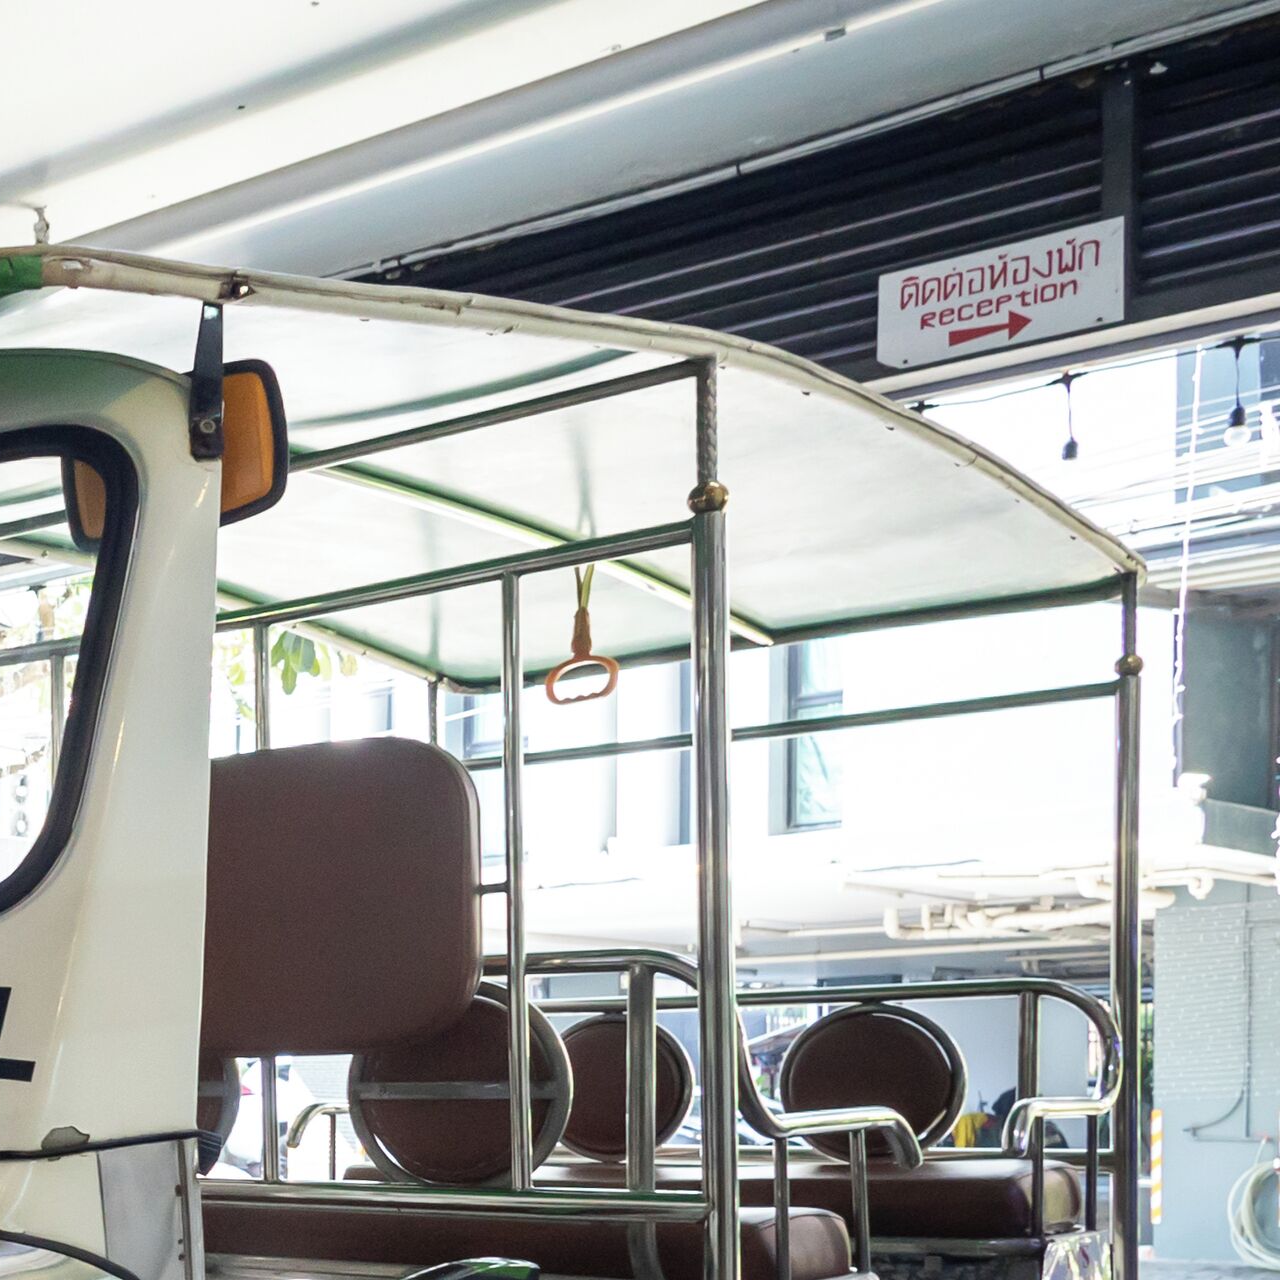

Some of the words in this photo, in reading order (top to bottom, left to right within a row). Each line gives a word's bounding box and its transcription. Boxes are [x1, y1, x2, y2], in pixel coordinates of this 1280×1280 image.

[900, 238, 1101, 311] ติดต่อห้องพัก
